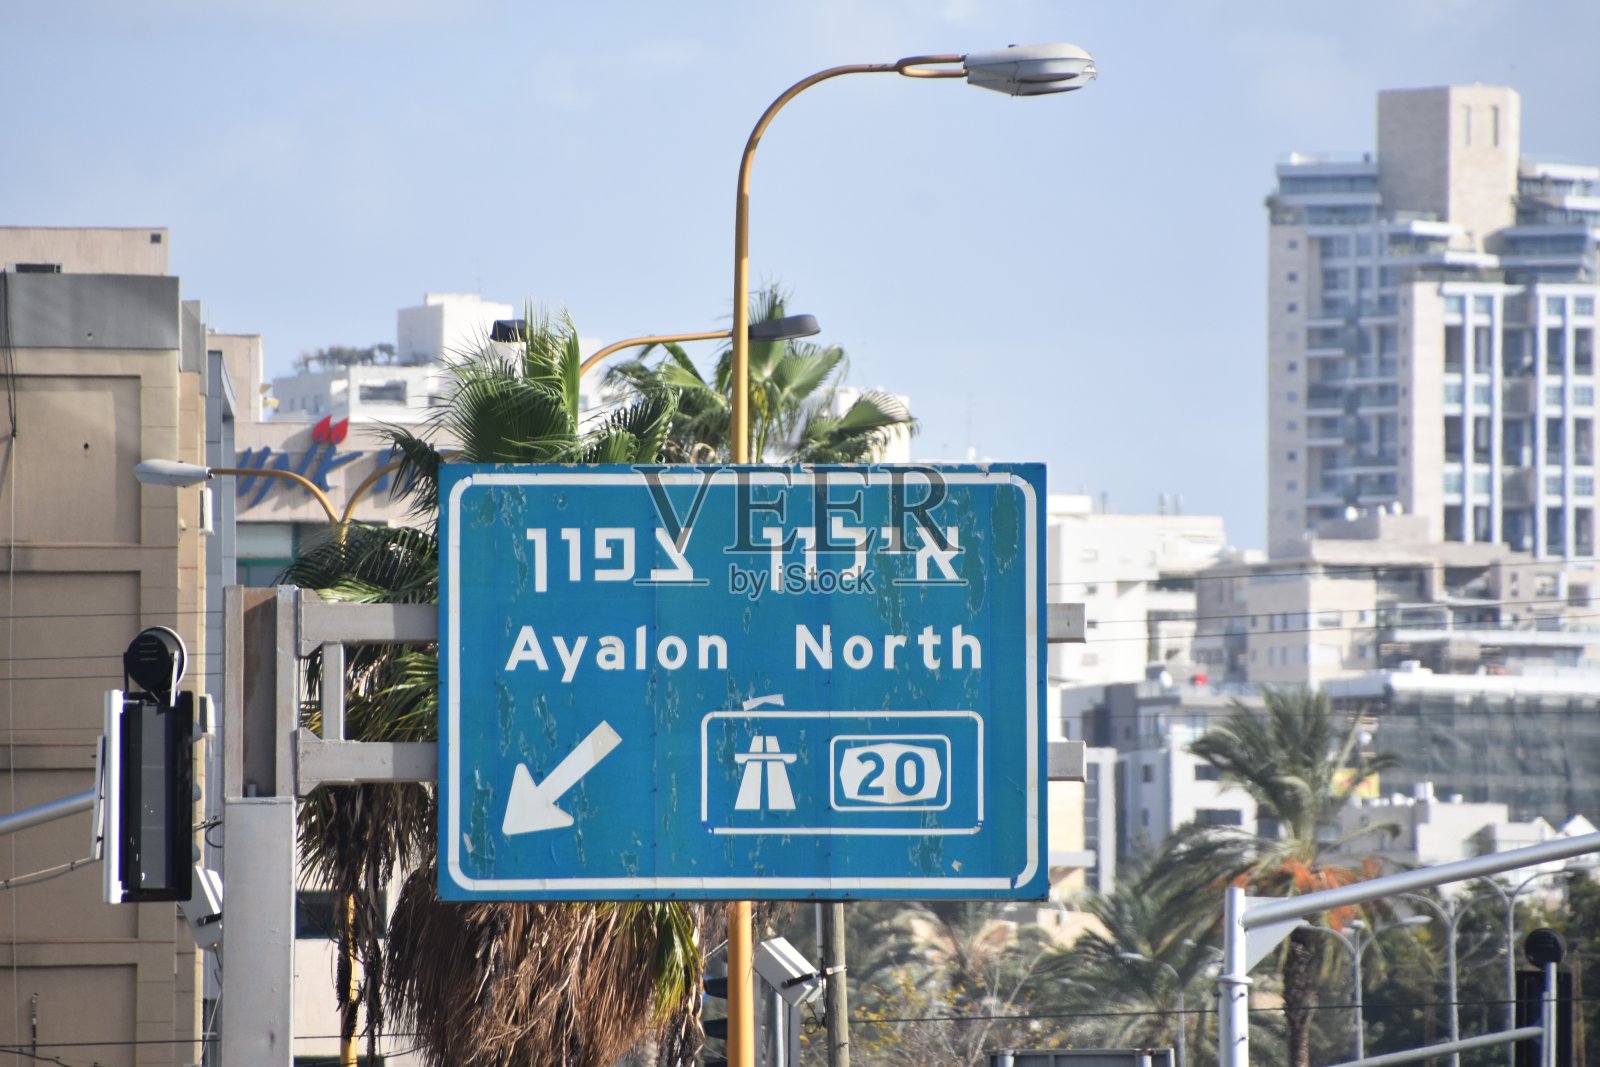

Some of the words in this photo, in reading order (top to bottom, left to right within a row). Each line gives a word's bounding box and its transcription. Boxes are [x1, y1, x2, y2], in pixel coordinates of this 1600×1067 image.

[526, 527, 694, 592] צפון
[763, 516, 960, 591] אילון
[504, 624, 729, 683] Ayalon
[795, 624, 982, 670] North
[856, 751, 925, 796] 20
